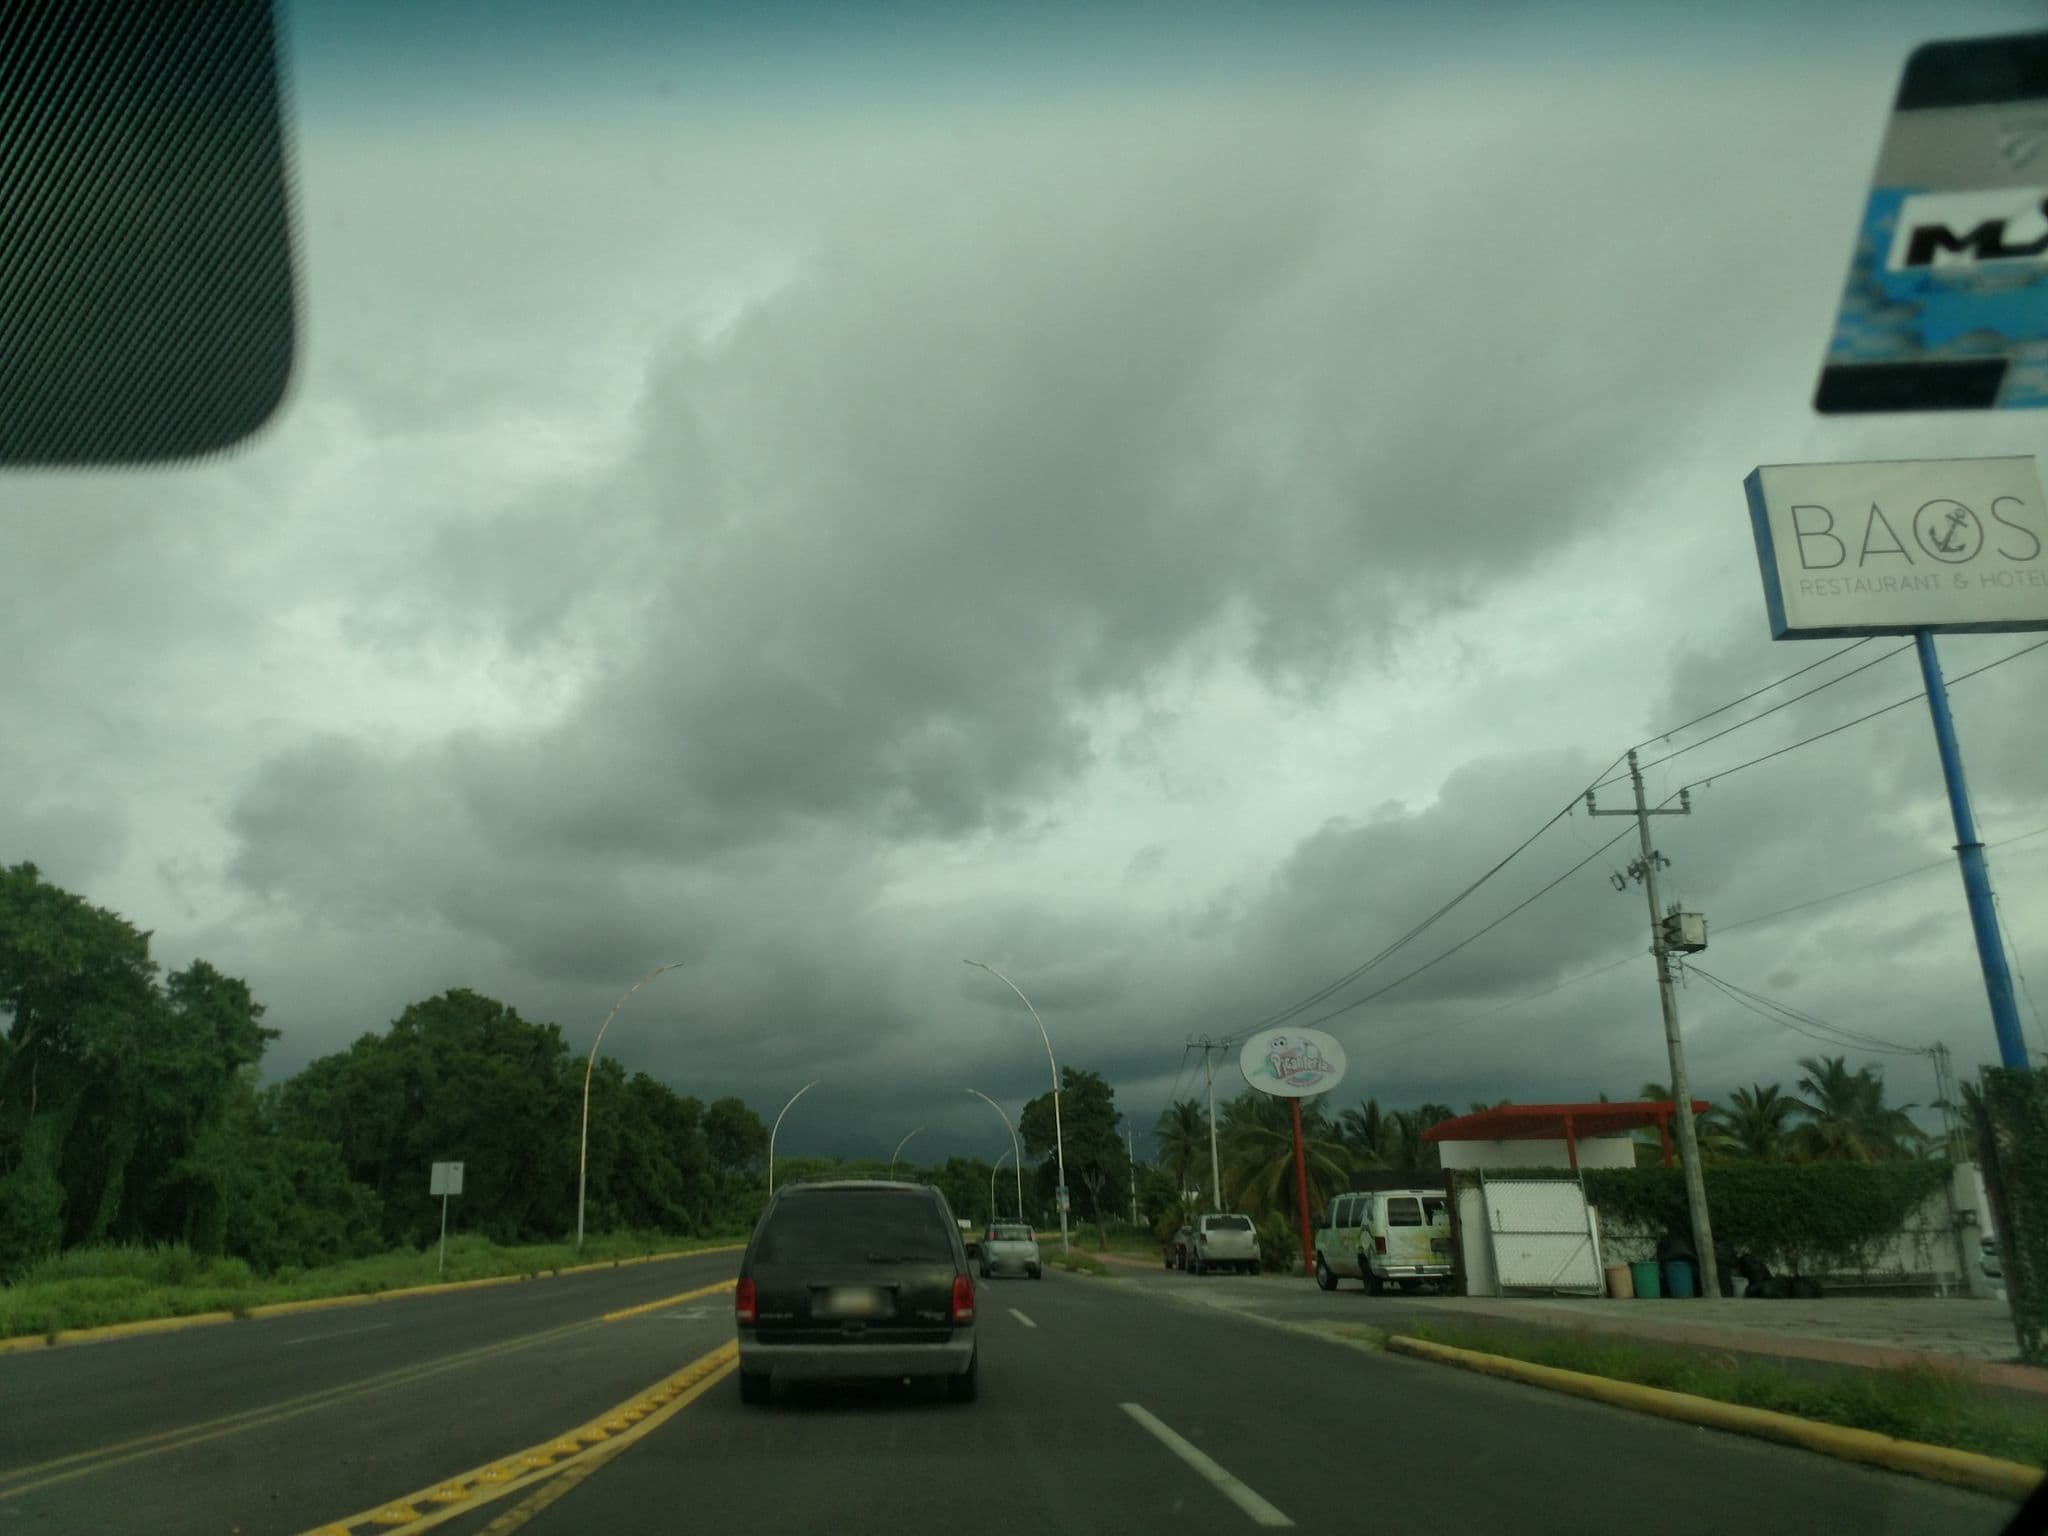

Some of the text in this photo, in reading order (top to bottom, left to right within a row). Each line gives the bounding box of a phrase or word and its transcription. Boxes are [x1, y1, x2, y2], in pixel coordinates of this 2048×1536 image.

[1791, 496, 2041, 569] BAOS
[1799, 573, 1941, 597] RESTAURANT
[1953, 573, 1969, 590] &
